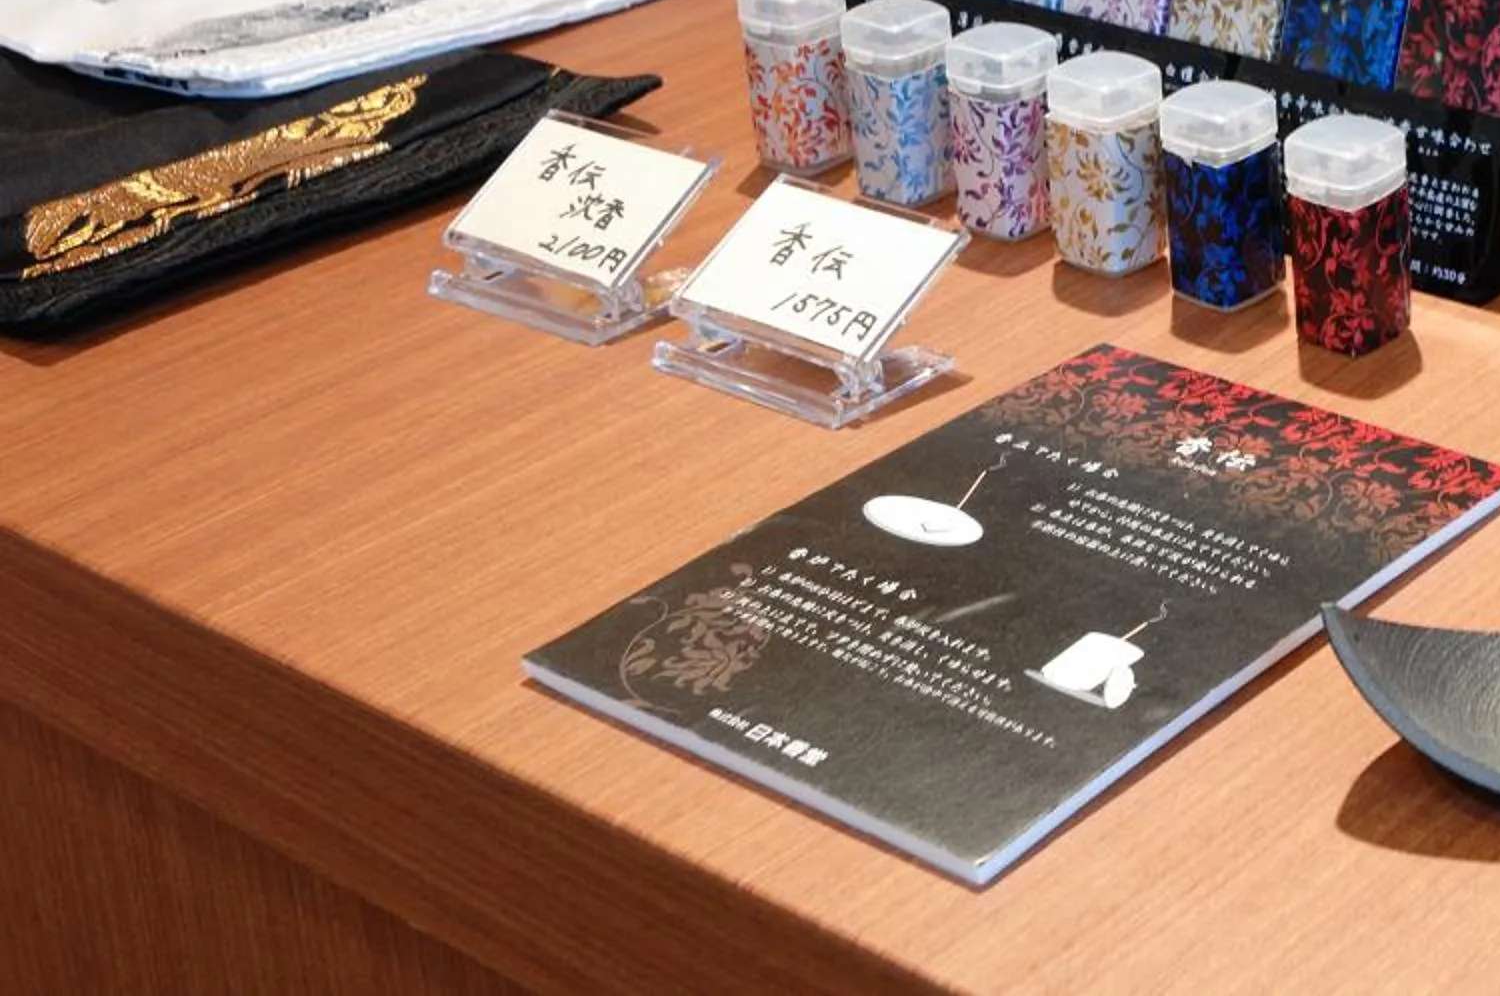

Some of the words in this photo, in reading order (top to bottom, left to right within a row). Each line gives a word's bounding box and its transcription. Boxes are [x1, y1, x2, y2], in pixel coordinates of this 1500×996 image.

[538, 143, 606, 191] 香伝
[537, 235, 629, 273] 2100円
[769, 221, 855, 281] 香伝
[771, 291, 879, 343] 1575円
